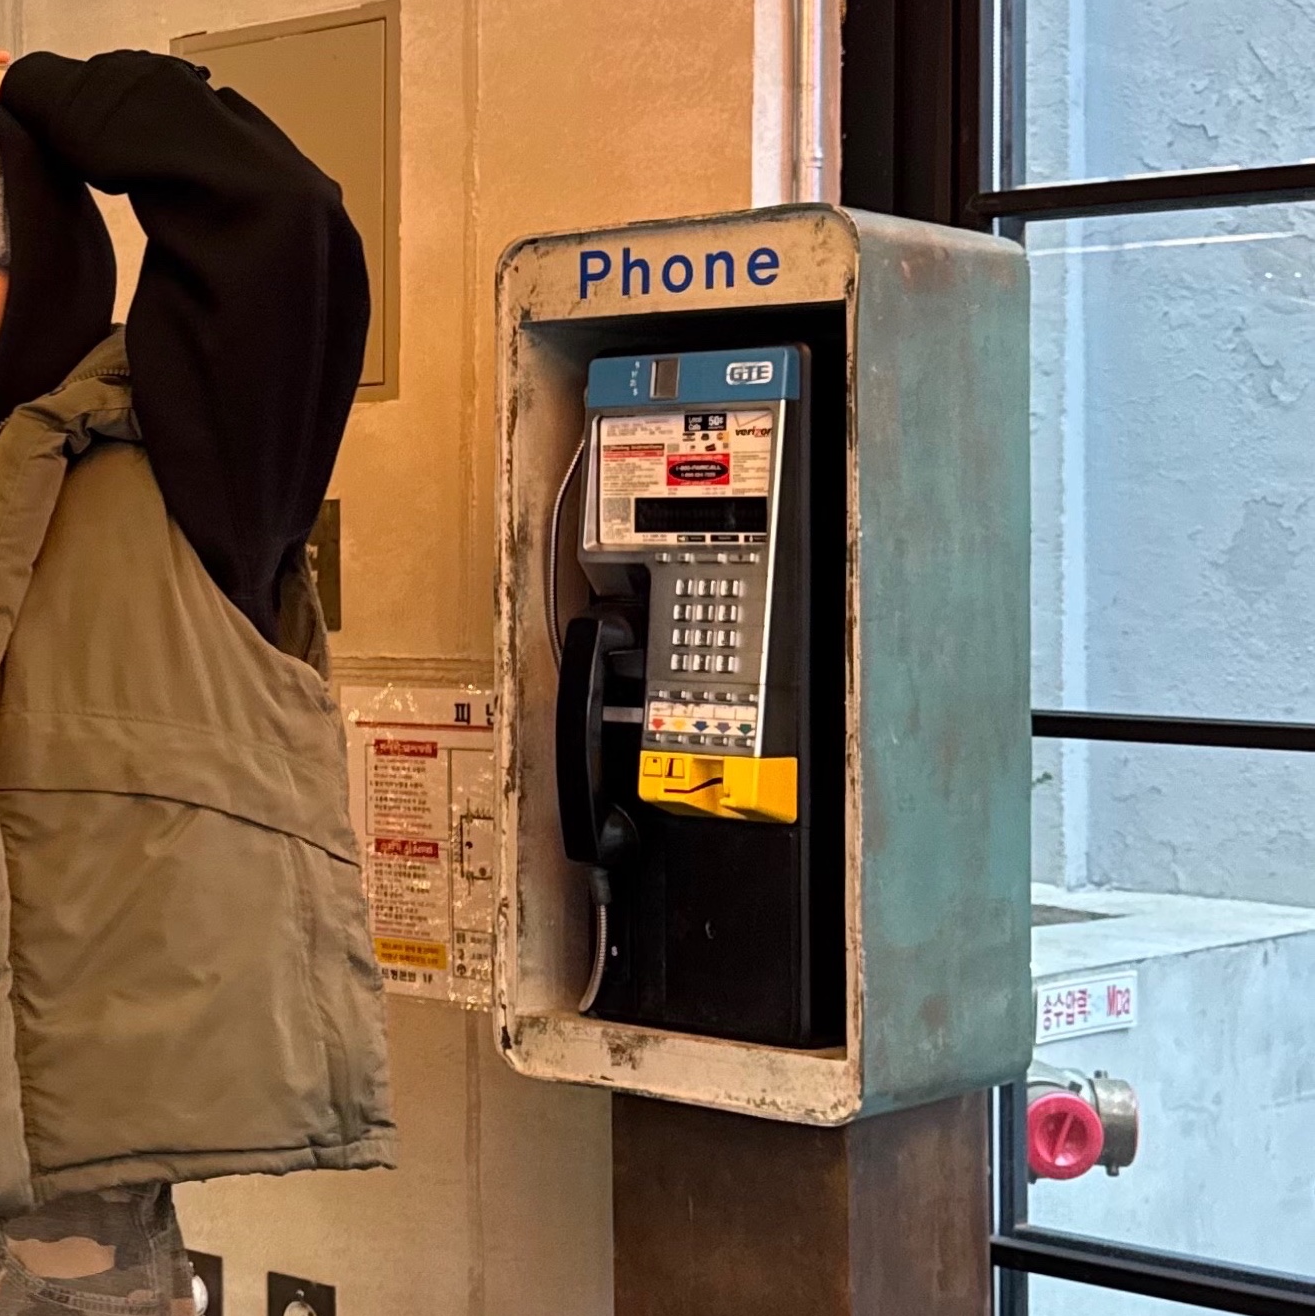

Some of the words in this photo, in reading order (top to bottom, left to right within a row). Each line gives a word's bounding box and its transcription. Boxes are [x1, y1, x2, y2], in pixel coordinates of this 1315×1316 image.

[579, 247, 780, 299] Phone
[728, 364, 771, 382] GTE
[1107, 985, 1130, 1018] Mpa
